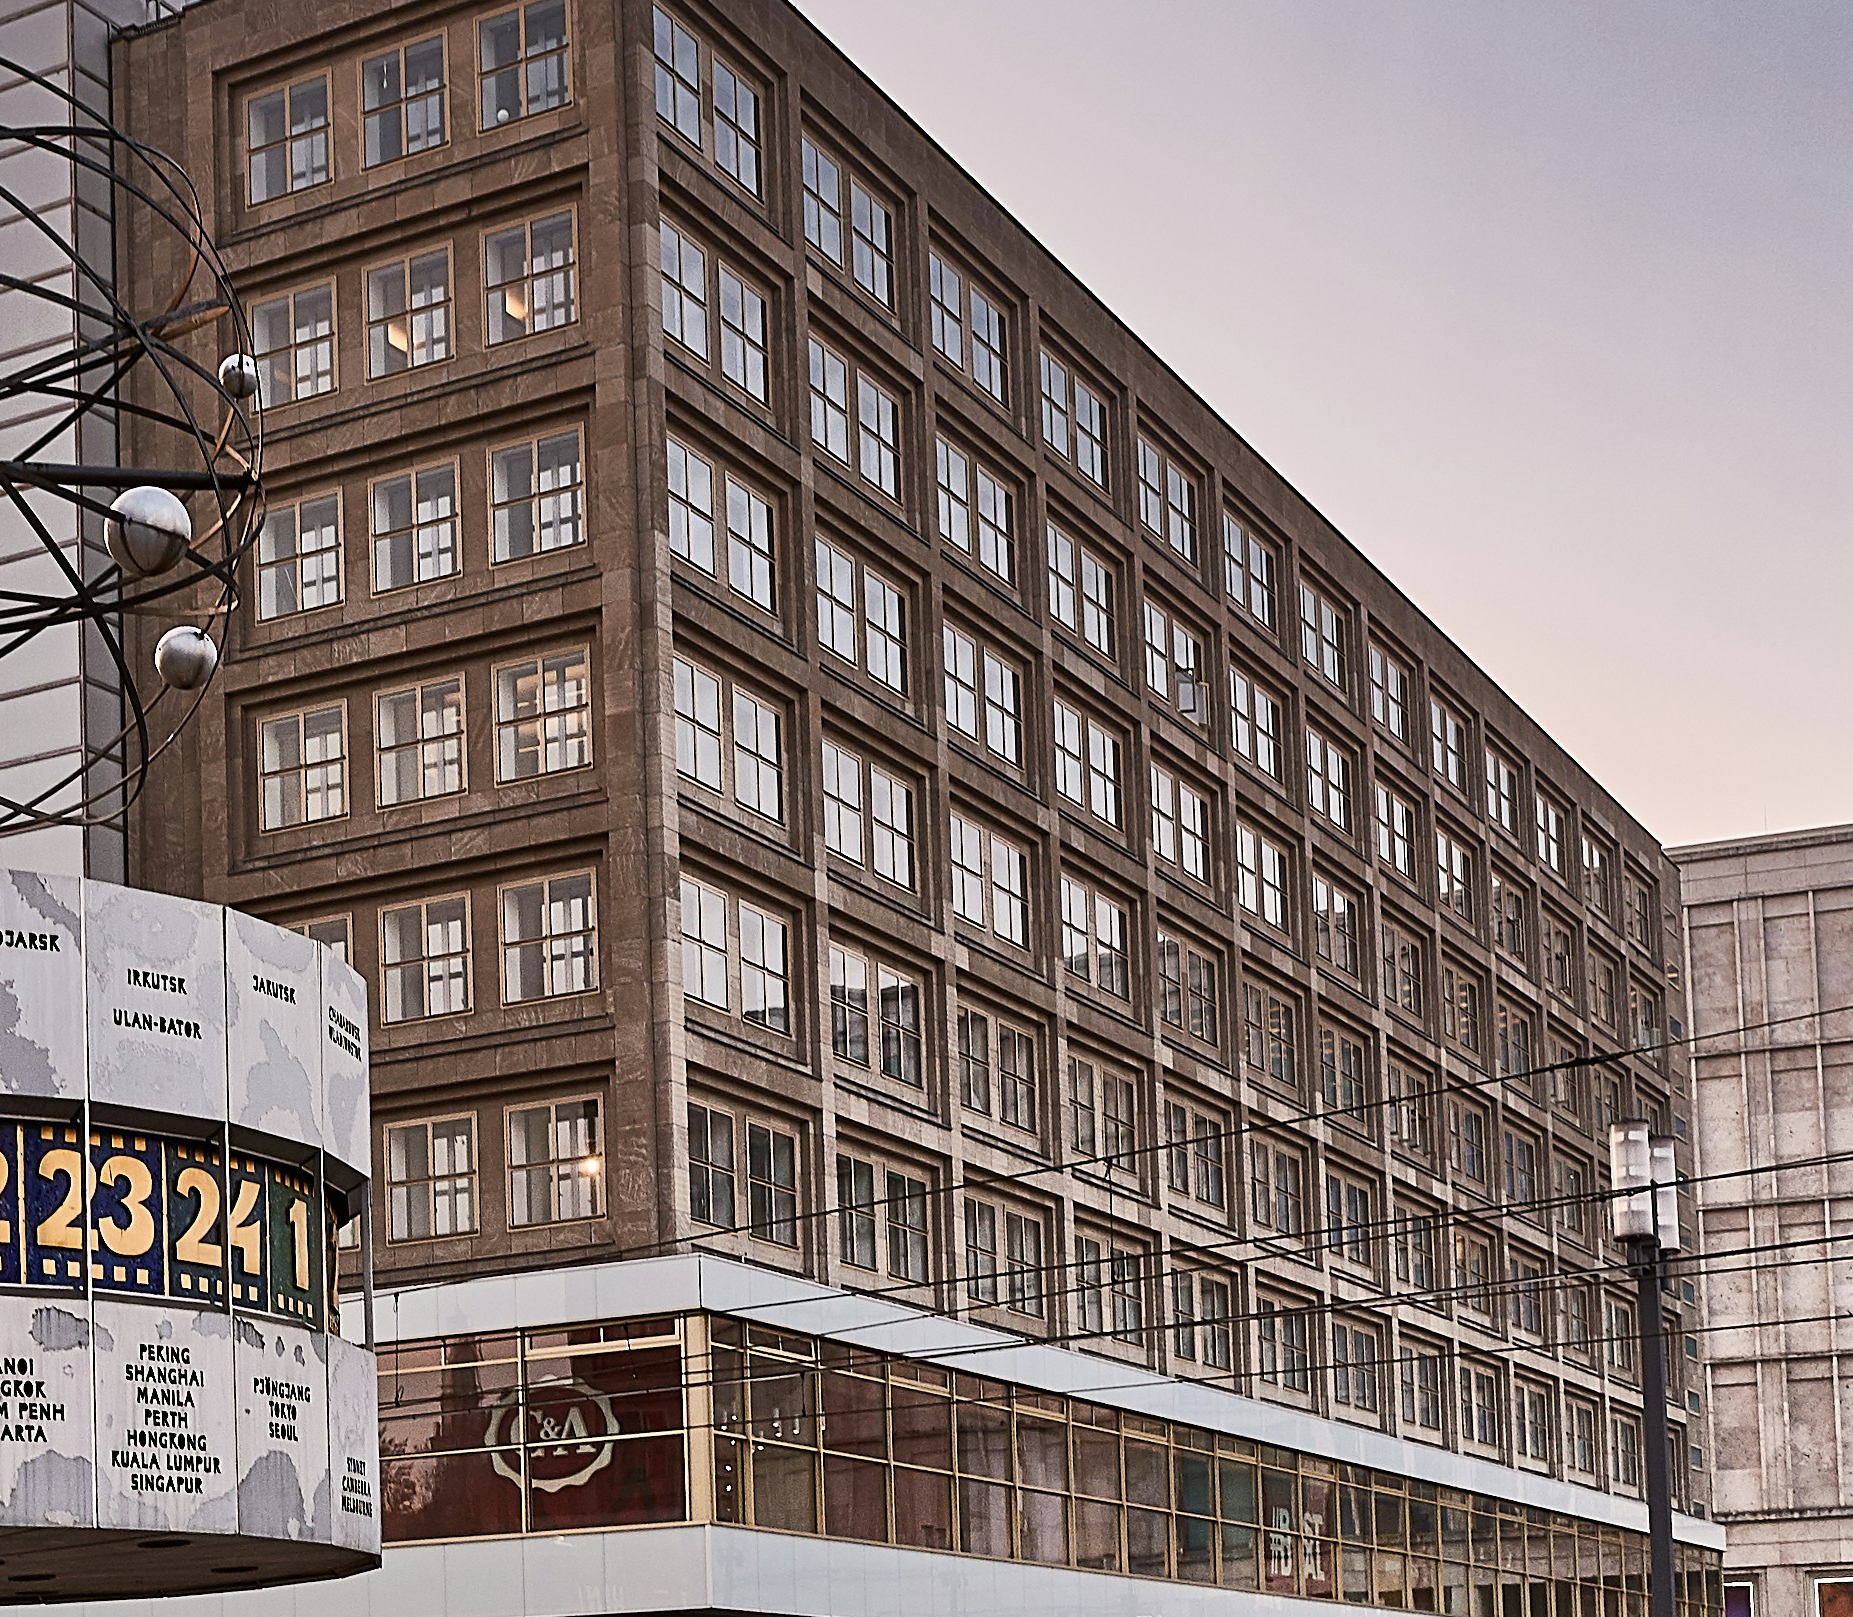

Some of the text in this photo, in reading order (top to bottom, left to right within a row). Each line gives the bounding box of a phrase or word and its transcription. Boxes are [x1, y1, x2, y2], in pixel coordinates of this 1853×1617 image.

[128, 968, 187, 995] IRKUTSK
[253, 975, 296, 1005] JAKUTSK
[113, 1008, 202, 1039] ULAN-BATOR
[36, 1148, 155, 1256] 23
[176, 1167, 260, 1275] 24
[289, 1198, 309, 1290] 1
[140, 1344, 190, 1364] PEKING
[126, 1364, 204, 1387] SHANGHAI
[137, 1387, 195, 1408] MANILA
[19, 1402, 65, 1421] PENH
[145, 1409, 188, 1429] PERTH
[269, 1400, 296, 1421] TOKYO
[127, 1429, 206, 1451] HONGKONG
[269, 1422, 298, 1442] SEOUL
[112, 1450, 221, 1474] KUALA LUMPUR
[131, 1474, 203, 1496] SINGAPUR
